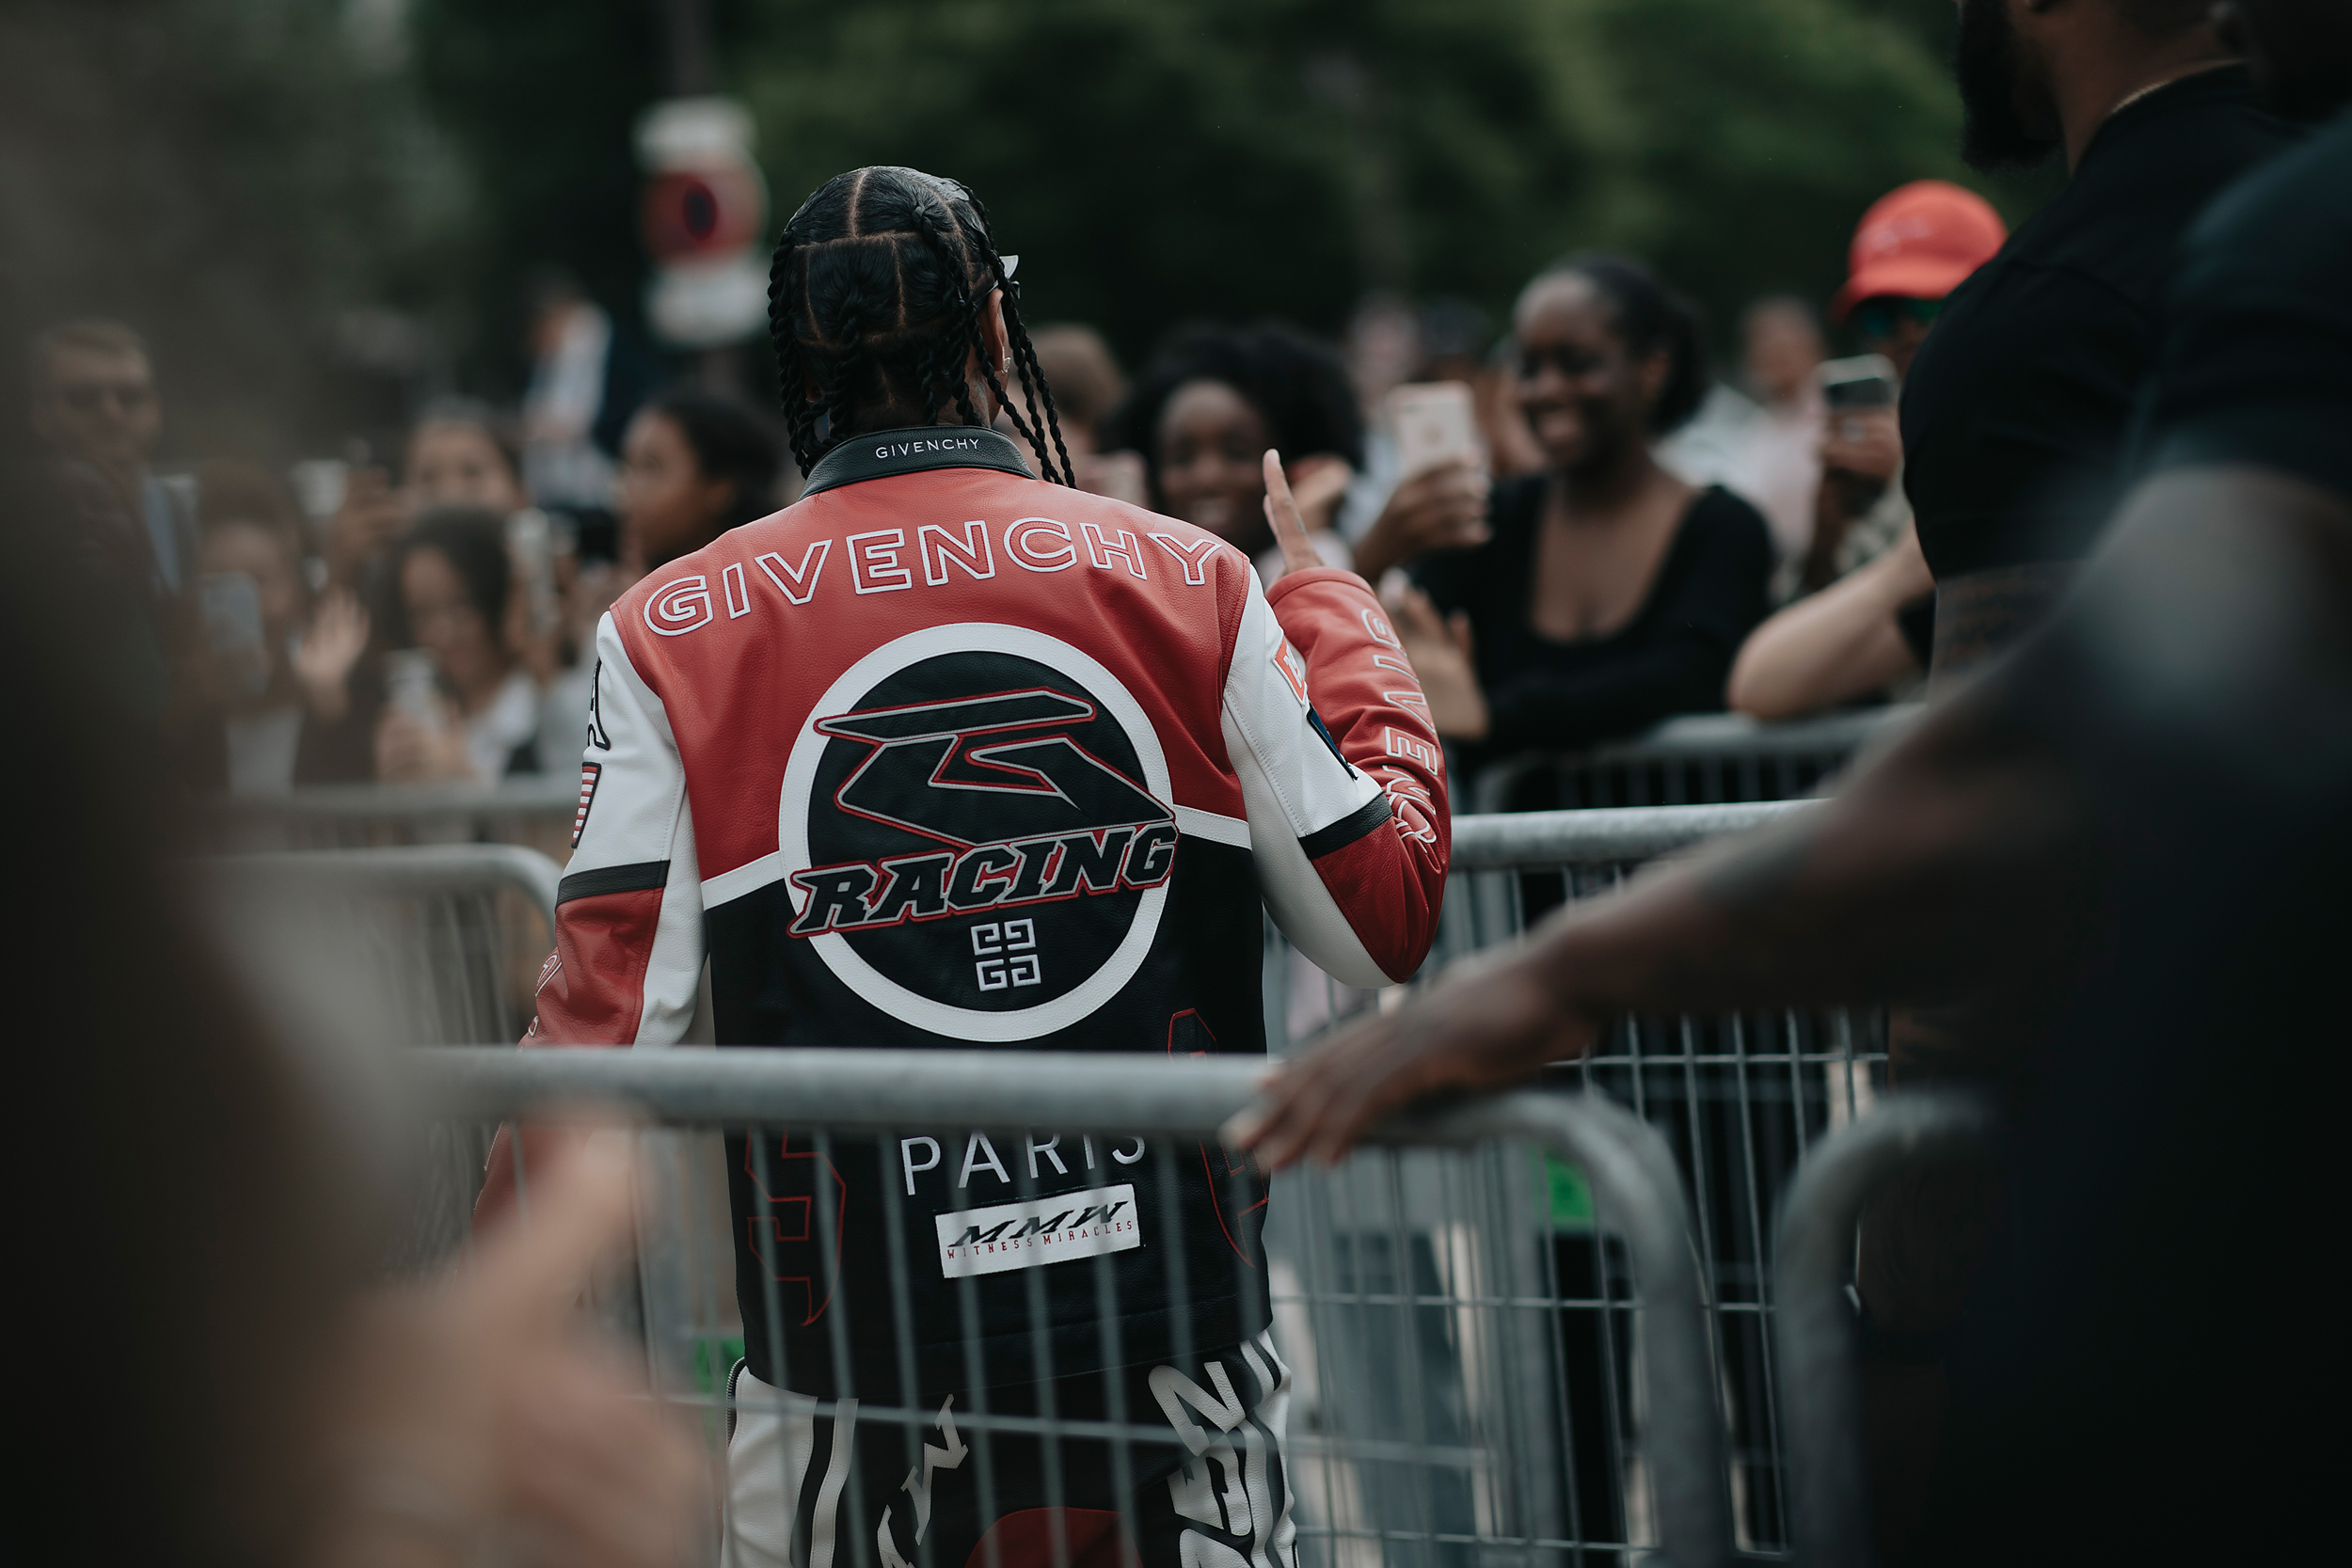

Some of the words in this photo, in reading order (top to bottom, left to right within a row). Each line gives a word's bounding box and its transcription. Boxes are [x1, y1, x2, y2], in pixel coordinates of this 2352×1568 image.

[875, 438, 979, 459] GIVENCHY
[644, 517, 1221, 636] GIVENCHY
[788, 820, 1180, 937] RACING
[946, 1236, 1033, 1259] WITNESS
[1043, 1220, 1133, 1245] MIRACLES
[947, 1200, 1128, 1248] MMW
